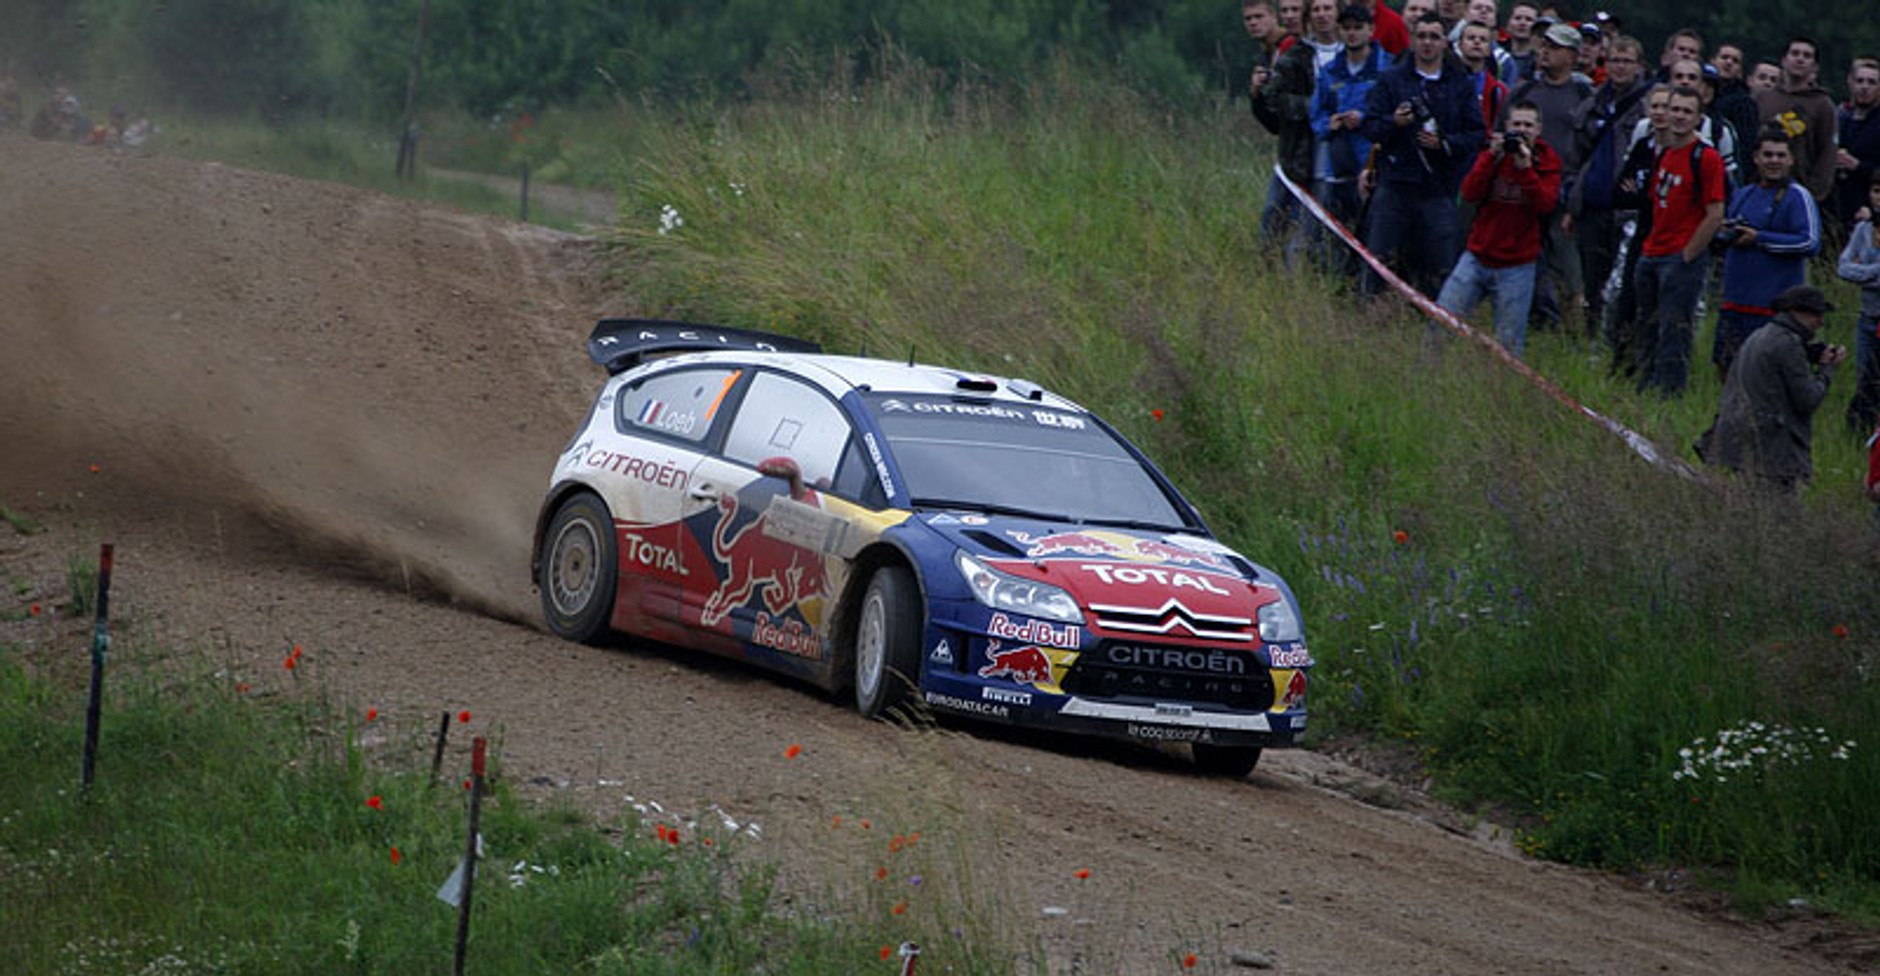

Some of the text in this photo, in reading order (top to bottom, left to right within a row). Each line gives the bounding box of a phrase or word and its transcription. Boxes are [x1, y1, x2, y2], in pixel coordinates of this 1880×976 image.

[656, 403, 697, 434] Loeb
[624, 533, 691, 576] TOTAL
[1081, 564, 1231, 597] TOTAL
[752, 611, 822, 660] Red Bull
[988, 612, 1081, 649] Red Bull
[982, 686, 1032, 706] PIRELLI
